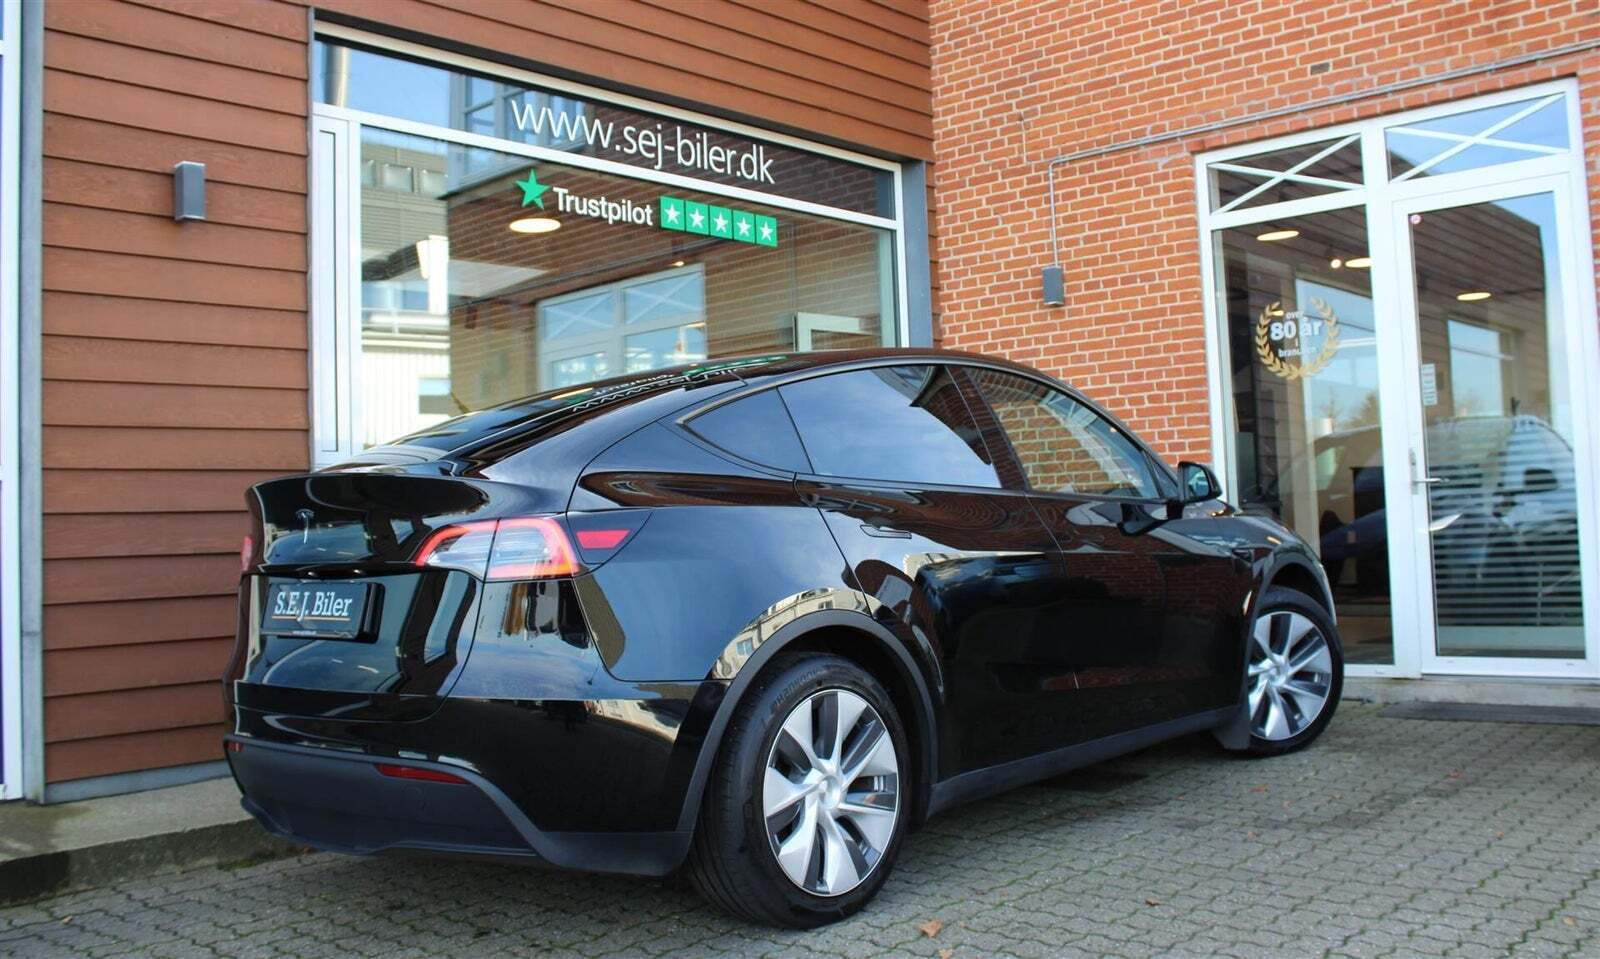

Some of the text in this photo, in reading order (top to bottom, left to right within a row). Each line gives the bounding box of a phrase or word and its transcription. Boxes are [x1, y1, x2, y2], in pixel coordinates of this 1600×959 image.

[511, 99, 775, 184] www.sej-biler.dk
[552, 186, 653, 226] Trustpilot
[1270, 317, 1322, 340] 80 år
[274, 591, 353, 622] S.E.J. Biler
